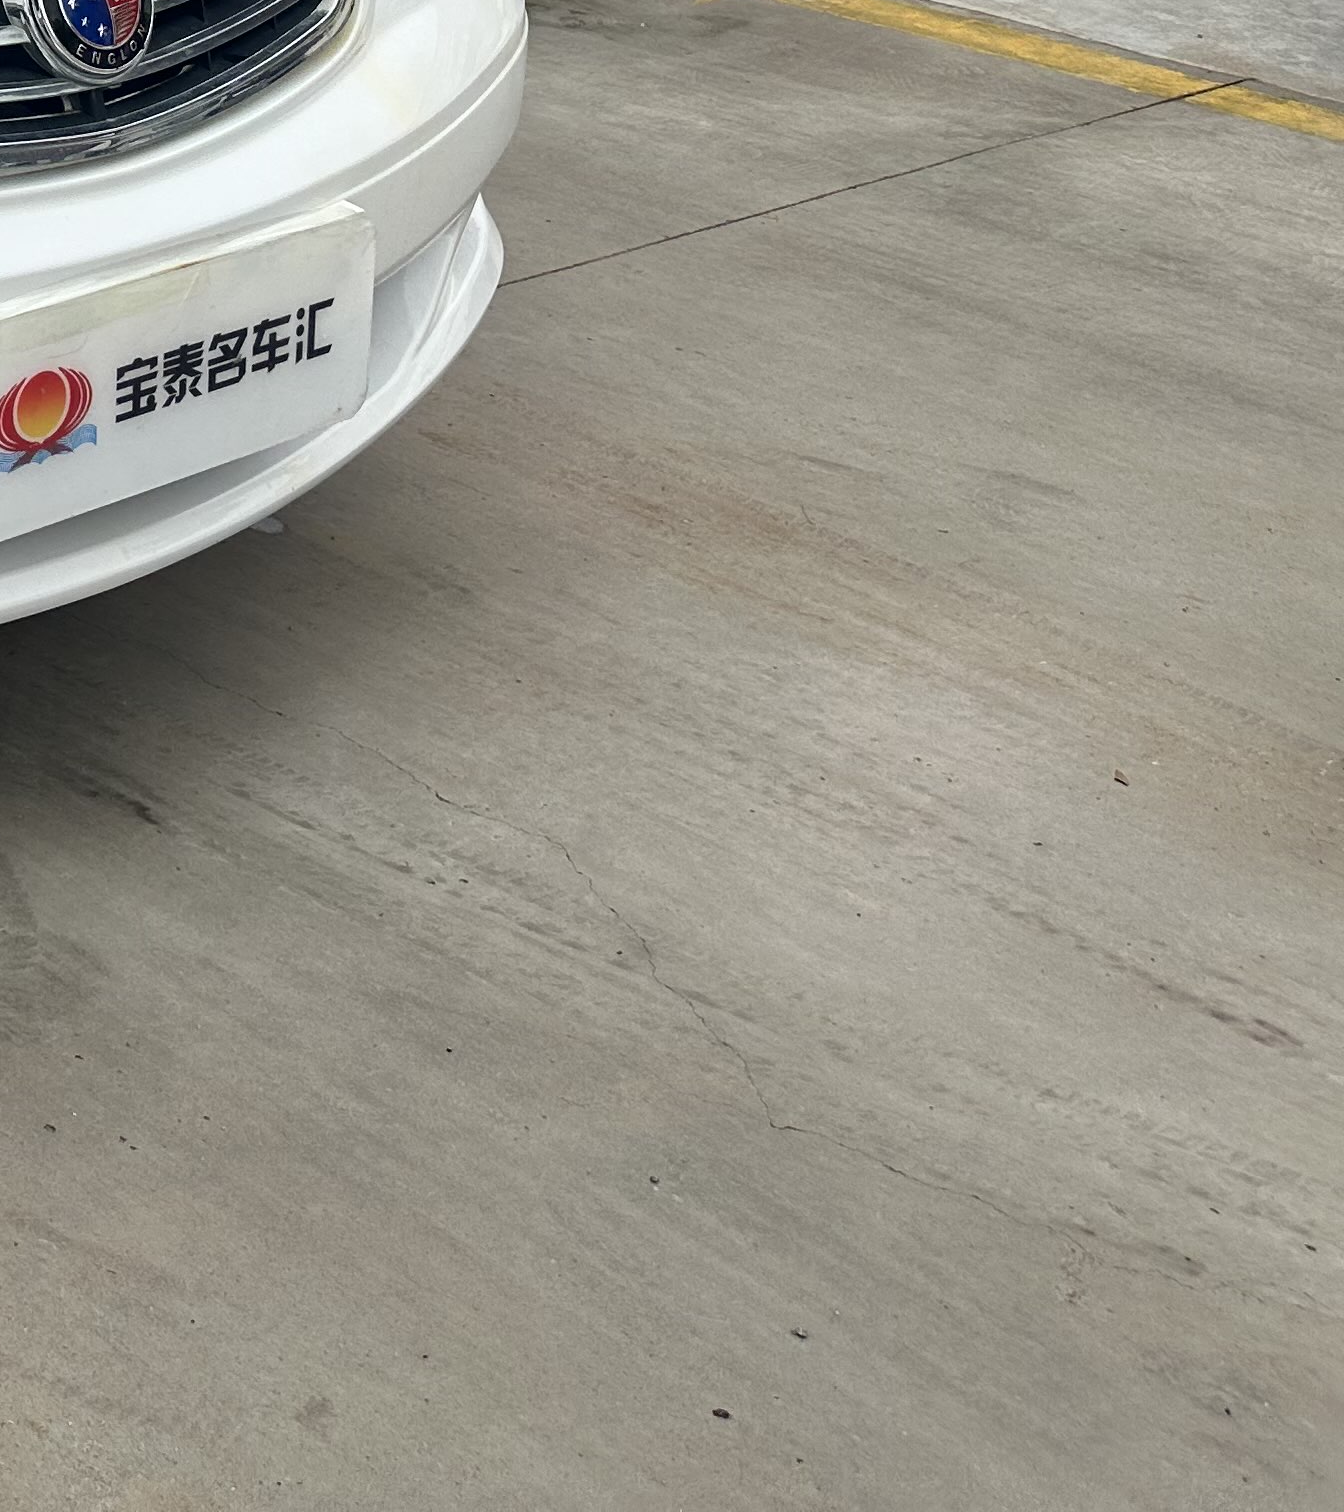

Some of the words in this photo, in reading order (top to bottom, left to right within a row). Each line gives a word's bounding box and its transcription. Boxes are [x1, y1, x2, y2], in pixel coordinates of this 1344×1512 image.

[75, 23, 148, 65] ENGLON
[115, 297, 334, 423] 宝泰名车汇
